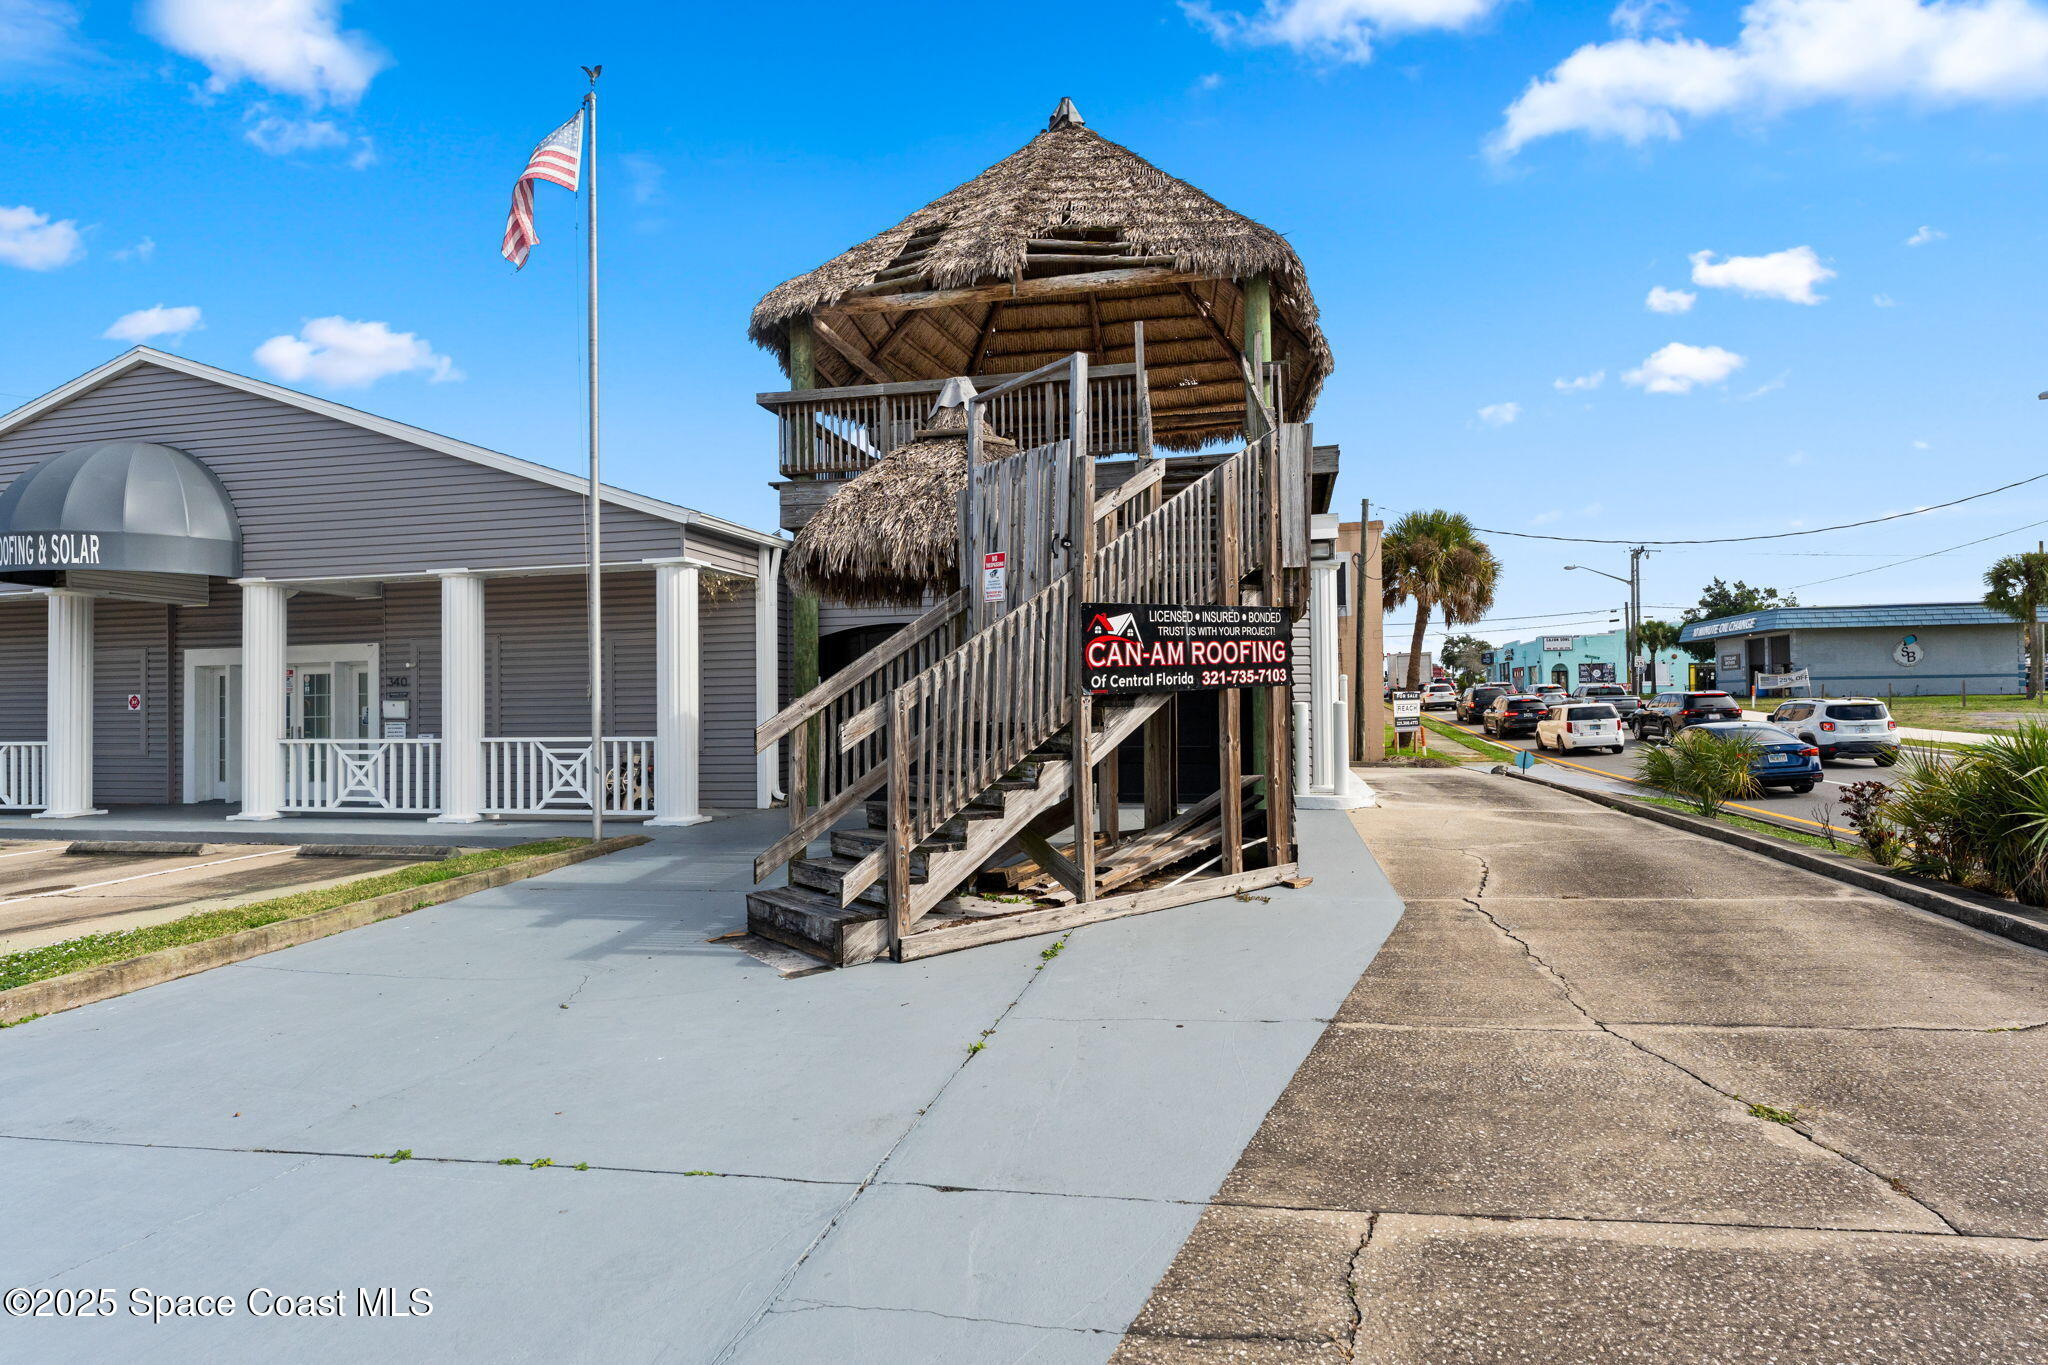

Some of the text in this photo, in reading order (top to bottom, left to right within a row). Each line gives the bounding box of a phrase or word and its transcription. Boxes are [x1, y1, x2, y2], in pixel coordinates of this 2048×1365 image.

[38, 534, 47, 565] &
[51, 534, 100, 565] SOLAR
[1149, 610, 1281, 623] LICENSED INSURED BONDED
[1158, 626, 1276, 636] TRUST US WITH YOUR PROJECT!
[1728, 617, 1758, 631] CHANGE
[1088, 640, 1286, 668] CAN-AM ROOFING
[388, 677, 408, 687] 340
[1091, 668, 1287, 688] Of Central Florida 321-735-7103
